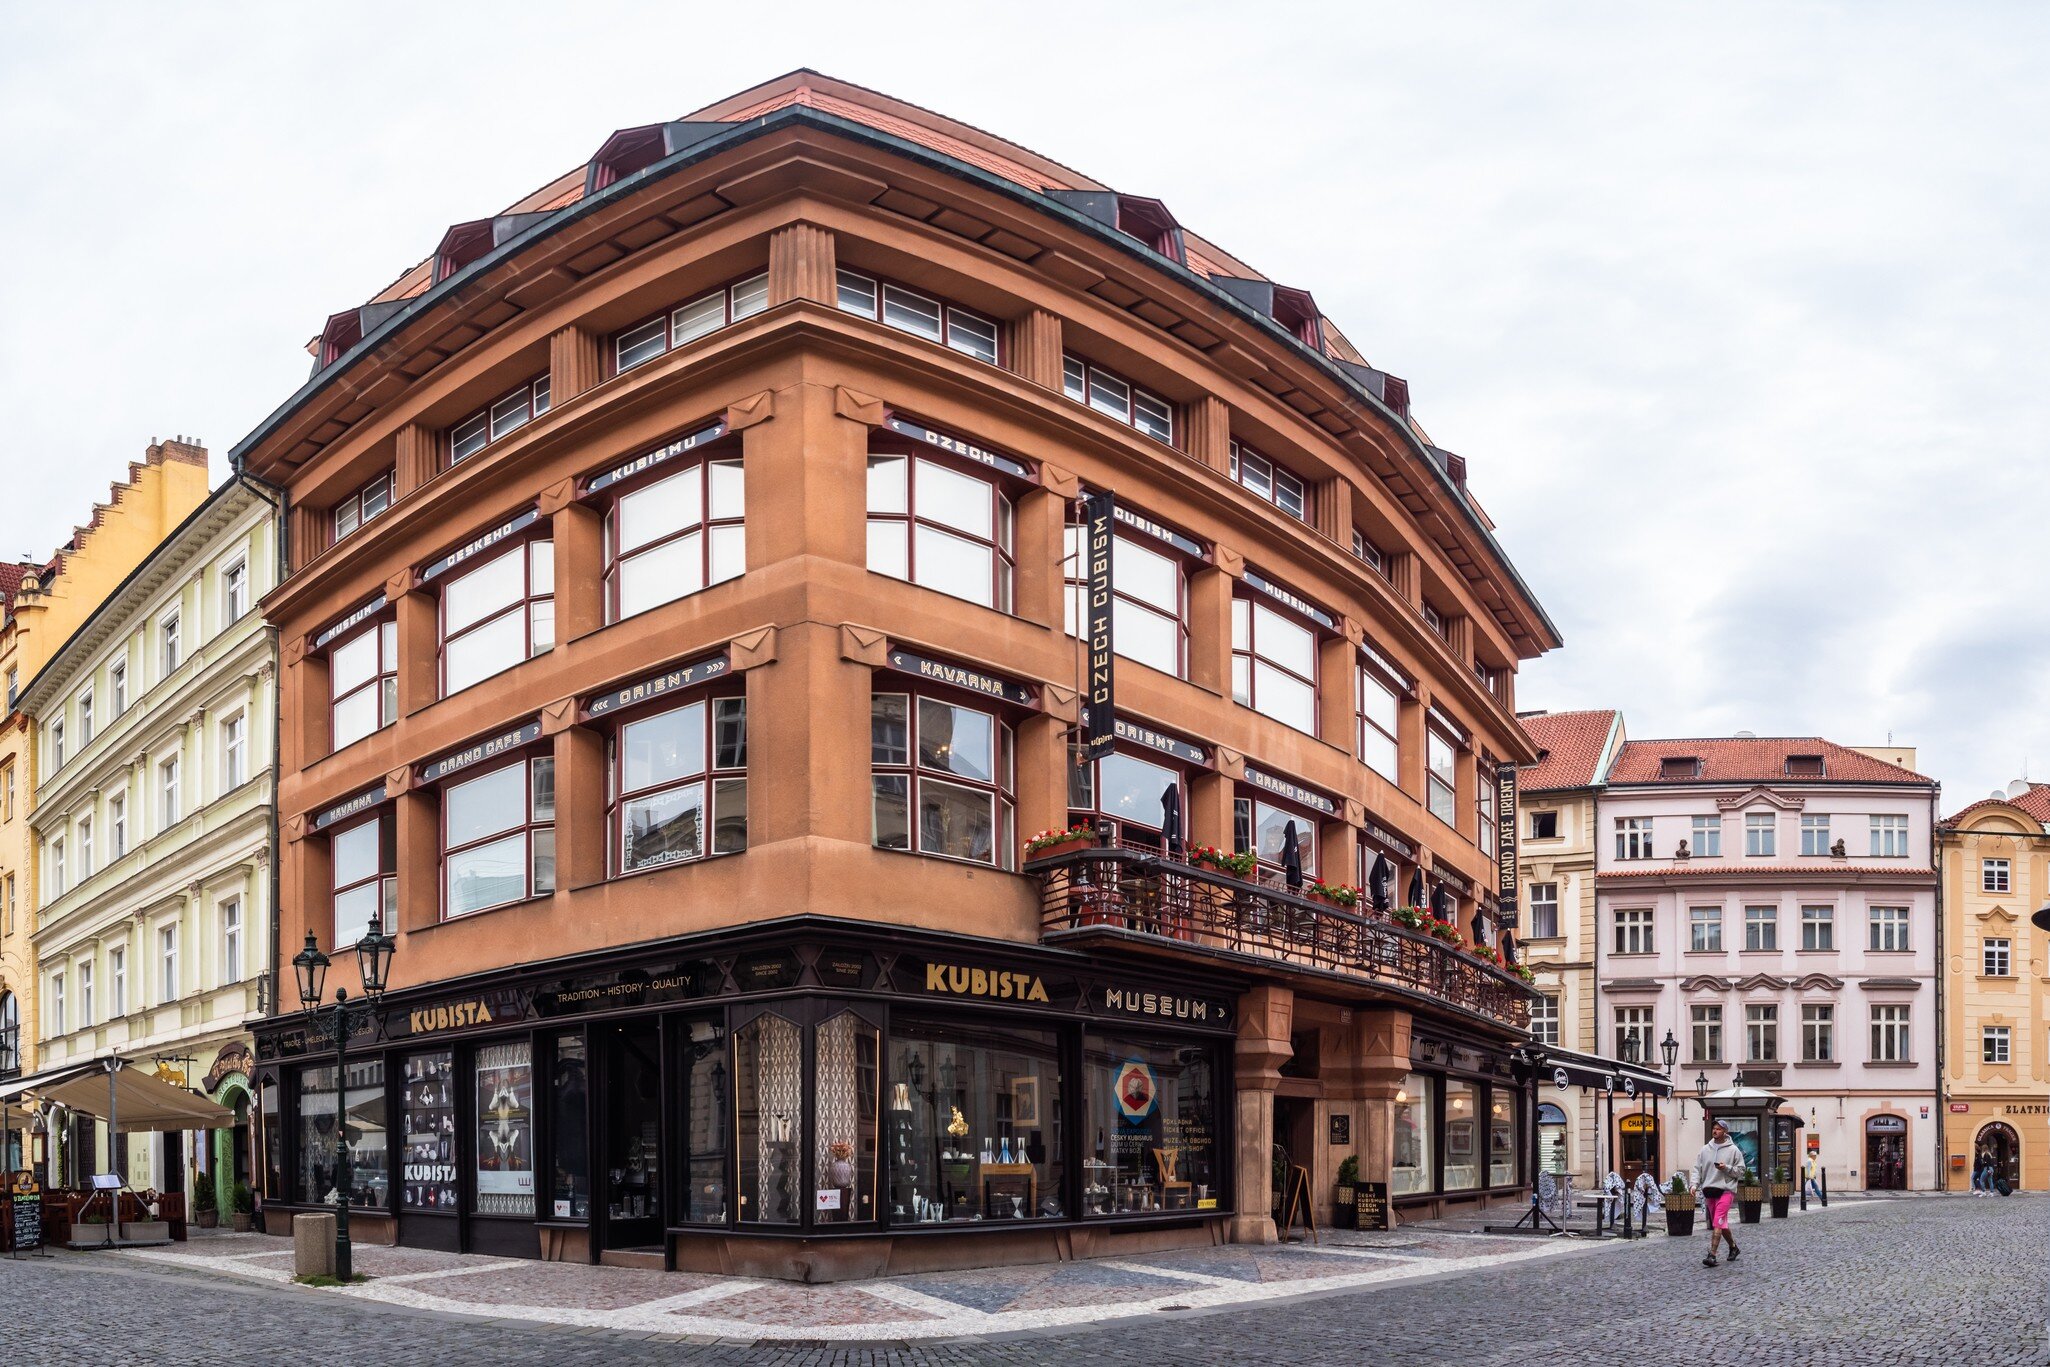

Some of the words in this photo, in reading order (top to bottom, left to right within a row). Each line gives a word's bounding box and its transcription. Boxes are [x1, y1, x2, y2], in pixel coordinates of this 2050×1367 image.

[611, 435, 697, 482] KUBISMU
[925, 430, 995, 465] CZECH
[1093, 515, 1108, 608] CUBISM
[1093, 616, 1109, 705] CZECH
[619, 668, 694, 705] ORIENT
[1115, 721, 1176, 751] ORIENT
[1500, 779, 1515, 817] ORIENT
[1501, 850, 1516, 890] GRAND
[557, 989, 600, 1003] TRADITION
[607, 984, 643, 998] HISTORY
[652, 976, 691, 989] QUALITY
[926, 963, 1050, 1003] KUBISTA
[410, 1000, 493, 1034] KUBISTA
[1106, 988, 1207, 1020] MUSEUM
[2006, 1105, 2050, 1114] ZLATNI
[404, 1165, 456, 1182] KUBISTA
